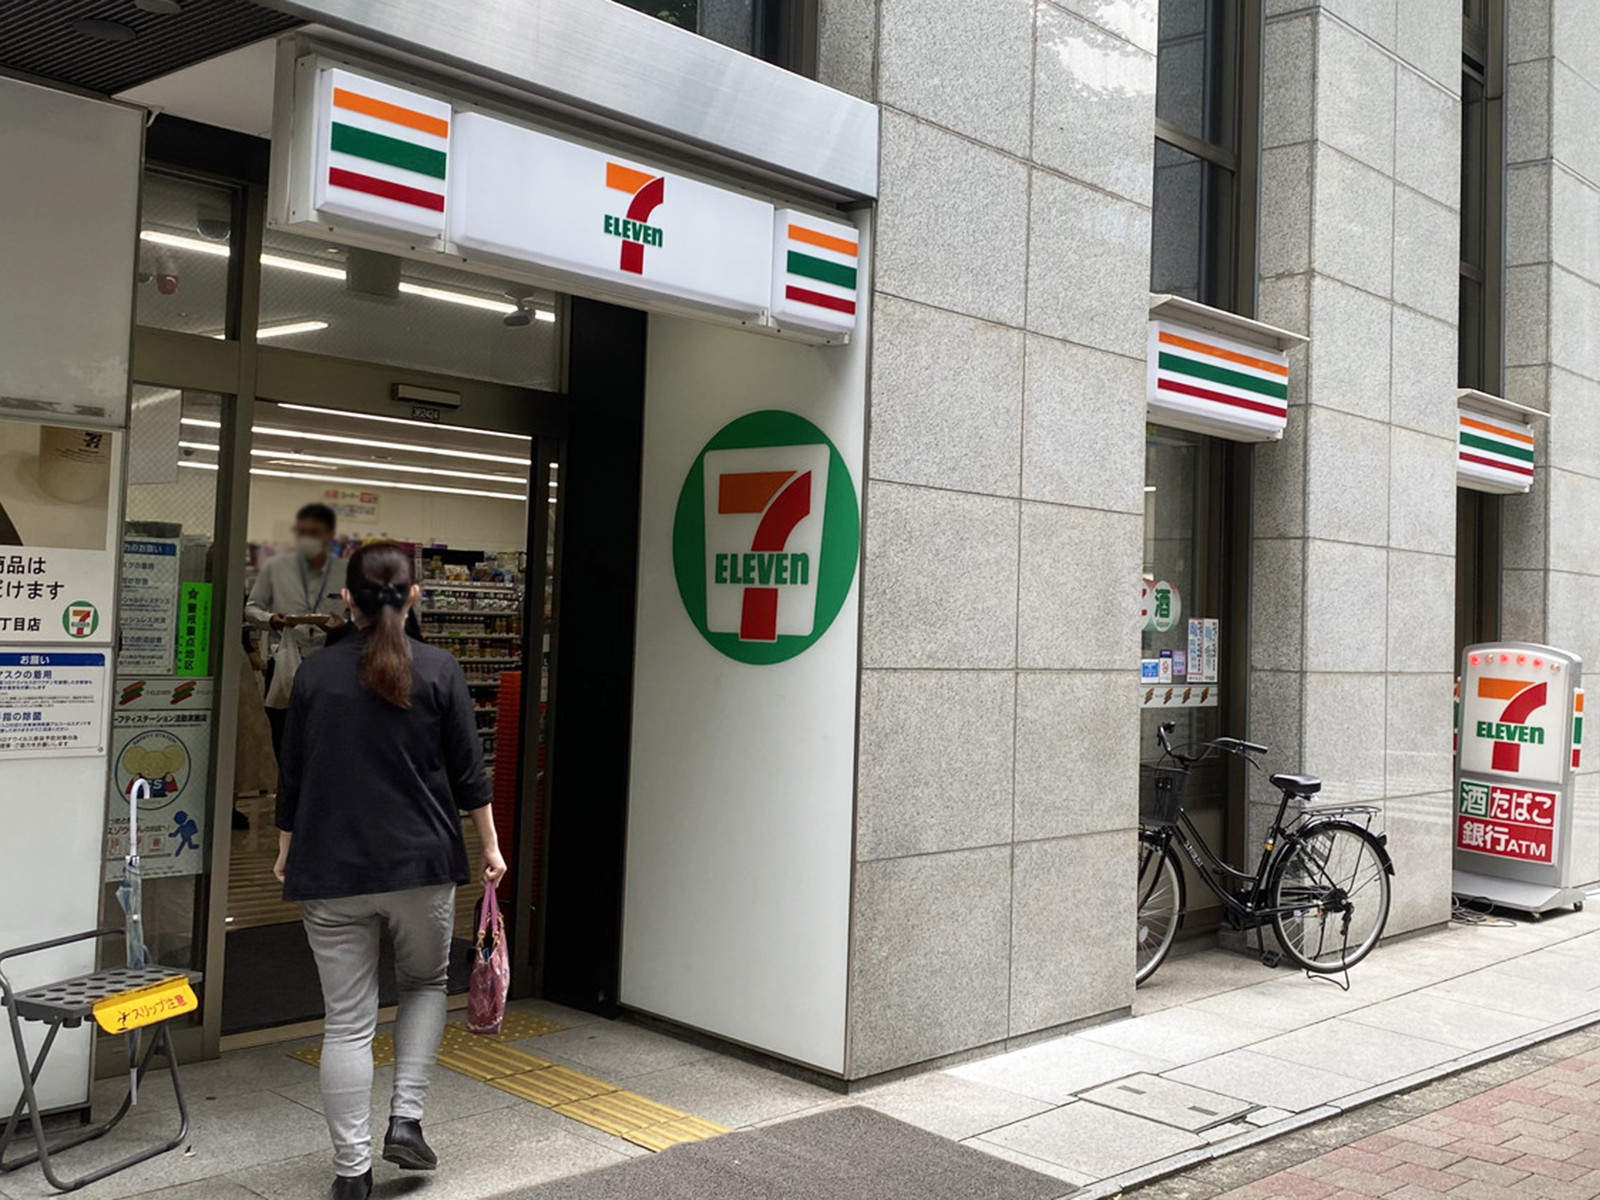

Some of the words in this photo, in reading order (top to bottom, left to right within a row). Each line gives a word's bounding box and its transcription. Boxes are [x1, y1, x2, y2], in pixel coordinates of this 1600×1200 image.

[606, 162, 664, 275] 7
[0, 579, 65, 600] けます
[718, 470, 812, 641] 7
[1155, 588, 1171, 618] 酒
[1477, 677, 1548, 773] 7
[1462, 785, 1488, 817] 酒
[1490, 788, 1552, 825] たばこ
